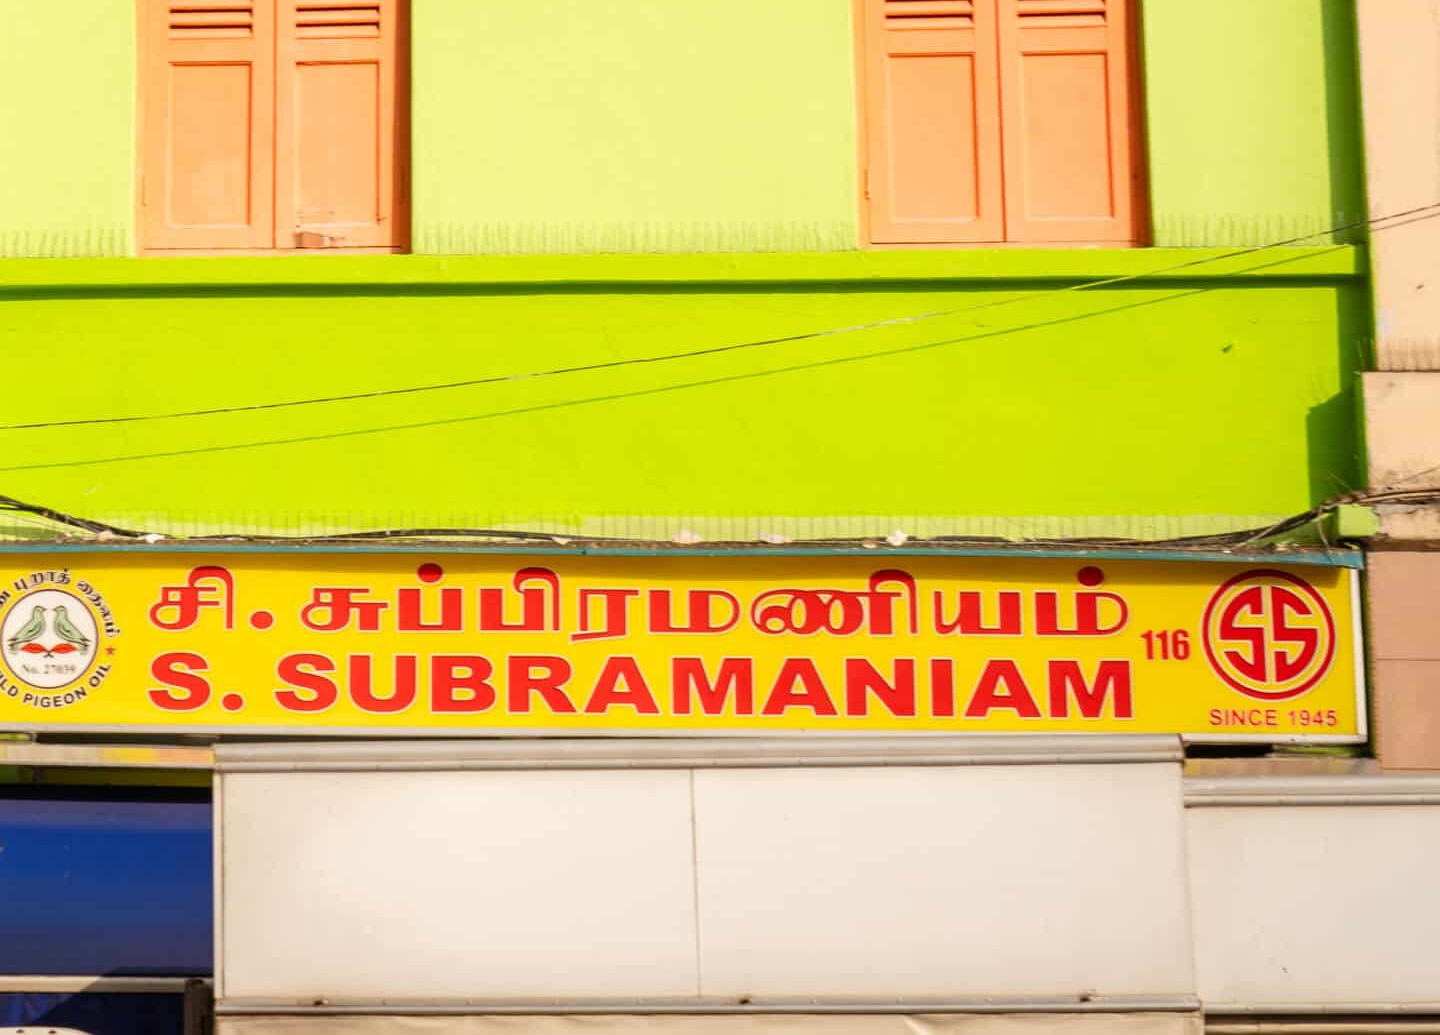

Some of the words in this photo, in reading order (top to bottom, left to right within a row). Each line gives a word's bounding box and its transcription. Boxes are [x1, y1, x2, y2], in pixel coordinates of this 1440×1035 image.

[302, 565, 1128, 640] சுப்பிரமணியம்
[1141, 629, 1189, 660] 116
[22, 687, 88, 709] PIGEON
[89, 663, 113, 688] OIL
[150, 653, 242, 710] S.
[276, 654, 1131, 717] SUBRAMANIAM
[1211, 710, 1276, 725] SINCE
[1290, 710, 1335, 725] 1945
